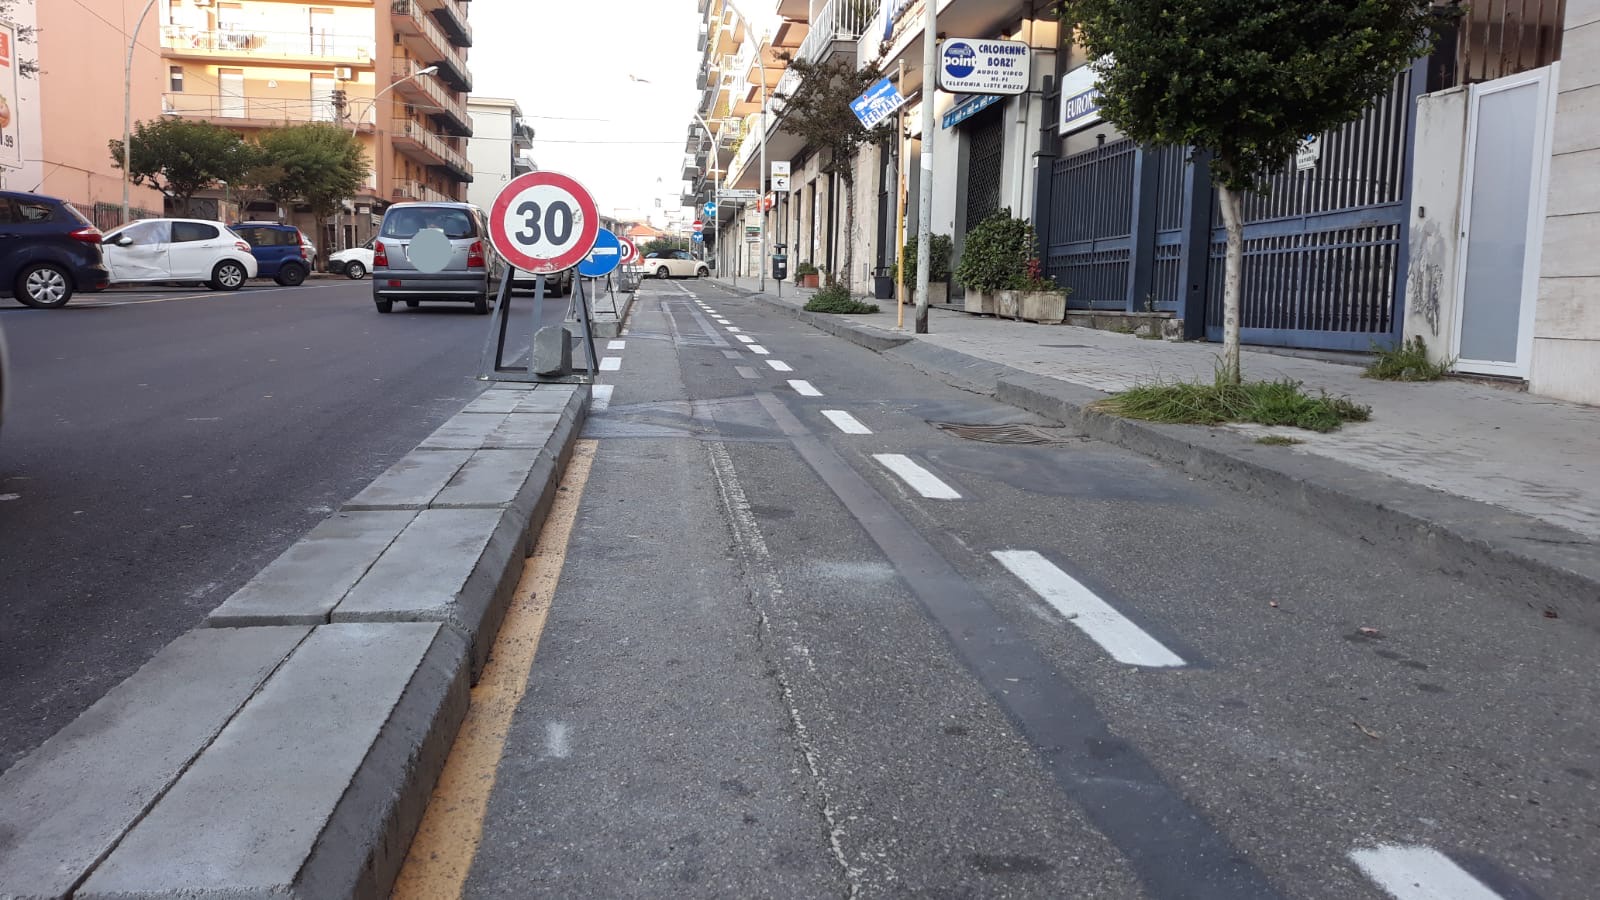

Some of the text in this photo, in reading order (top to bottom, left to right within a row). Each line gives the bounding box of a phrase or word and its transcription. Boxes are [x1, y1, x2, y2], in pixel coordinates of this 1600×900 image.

[978, 44, 1027, 56] CALORENNE
[987, 57, 1017, 67] BORZI'
[945, 80, 981, 88] TELEFONIA
[862, 94, 903, 127] FERMATA
[515, 200, 573, 246] 30
